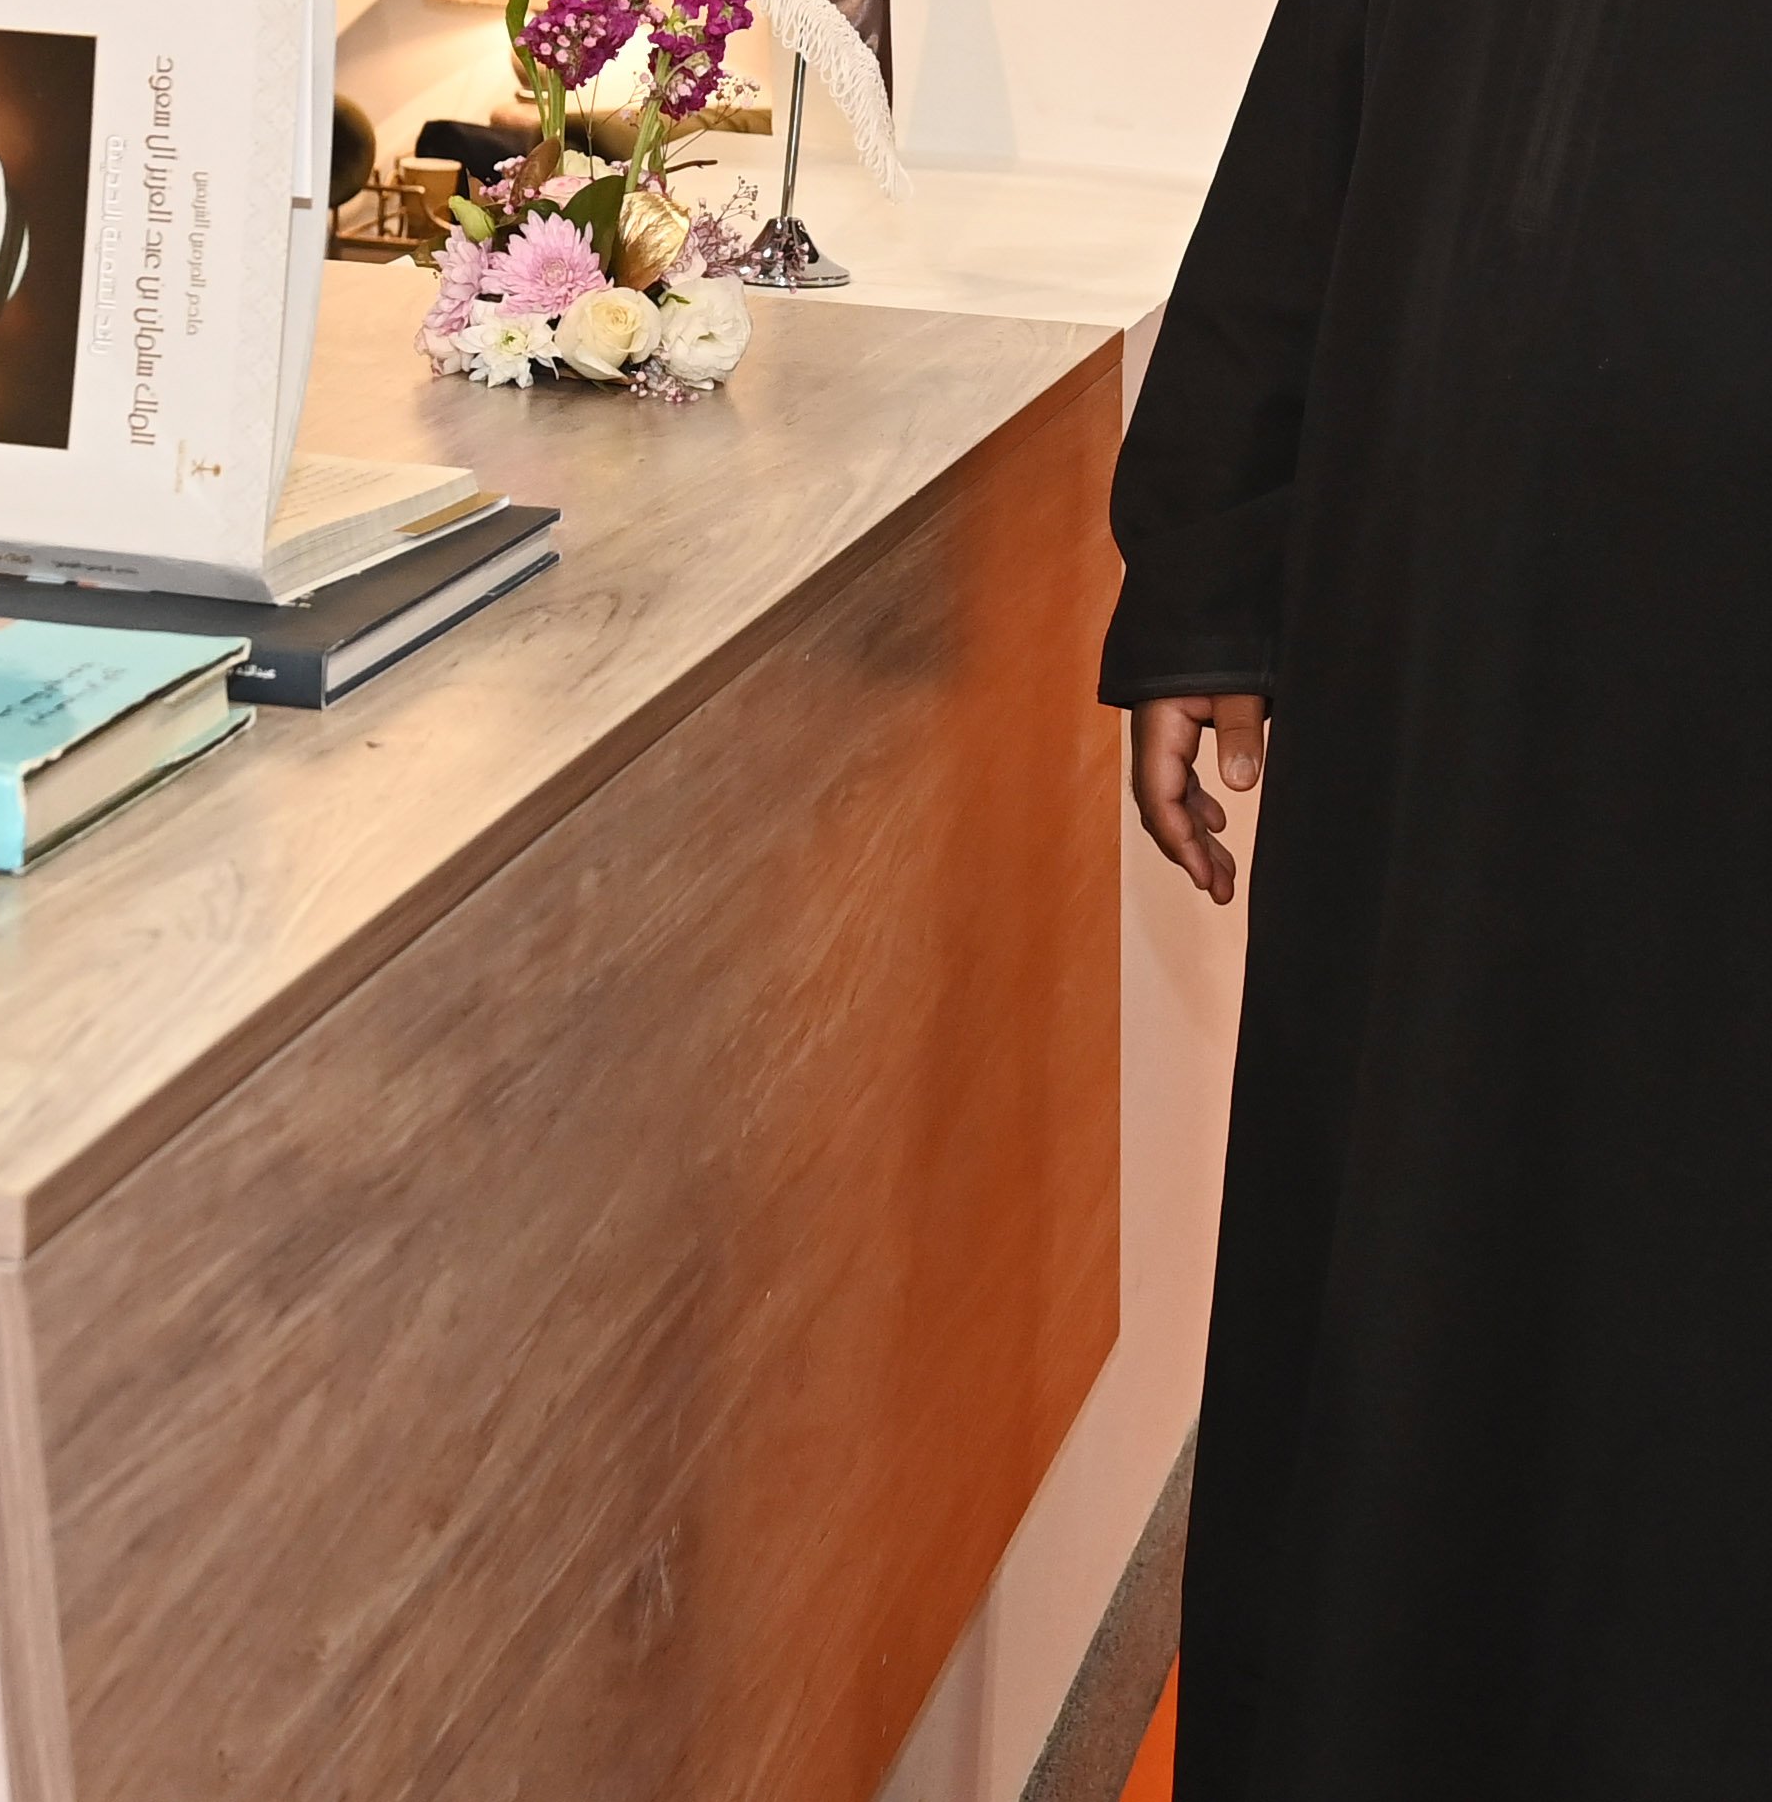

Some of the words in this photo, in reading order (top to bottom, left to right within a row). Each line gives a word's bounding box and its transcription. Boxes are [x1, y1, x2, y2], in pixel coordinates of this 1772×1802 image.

[148, 54, 176, 128] سعود
[141, 163, 174, 224] العزيز
[93, 225, 125, 309] التنمية
[142, 228, 167, 270] عبد
[134, 275, 161, 300] بن
[131, 307, 167, 378] سلمان
[127, 382, 161, 446] الملك
